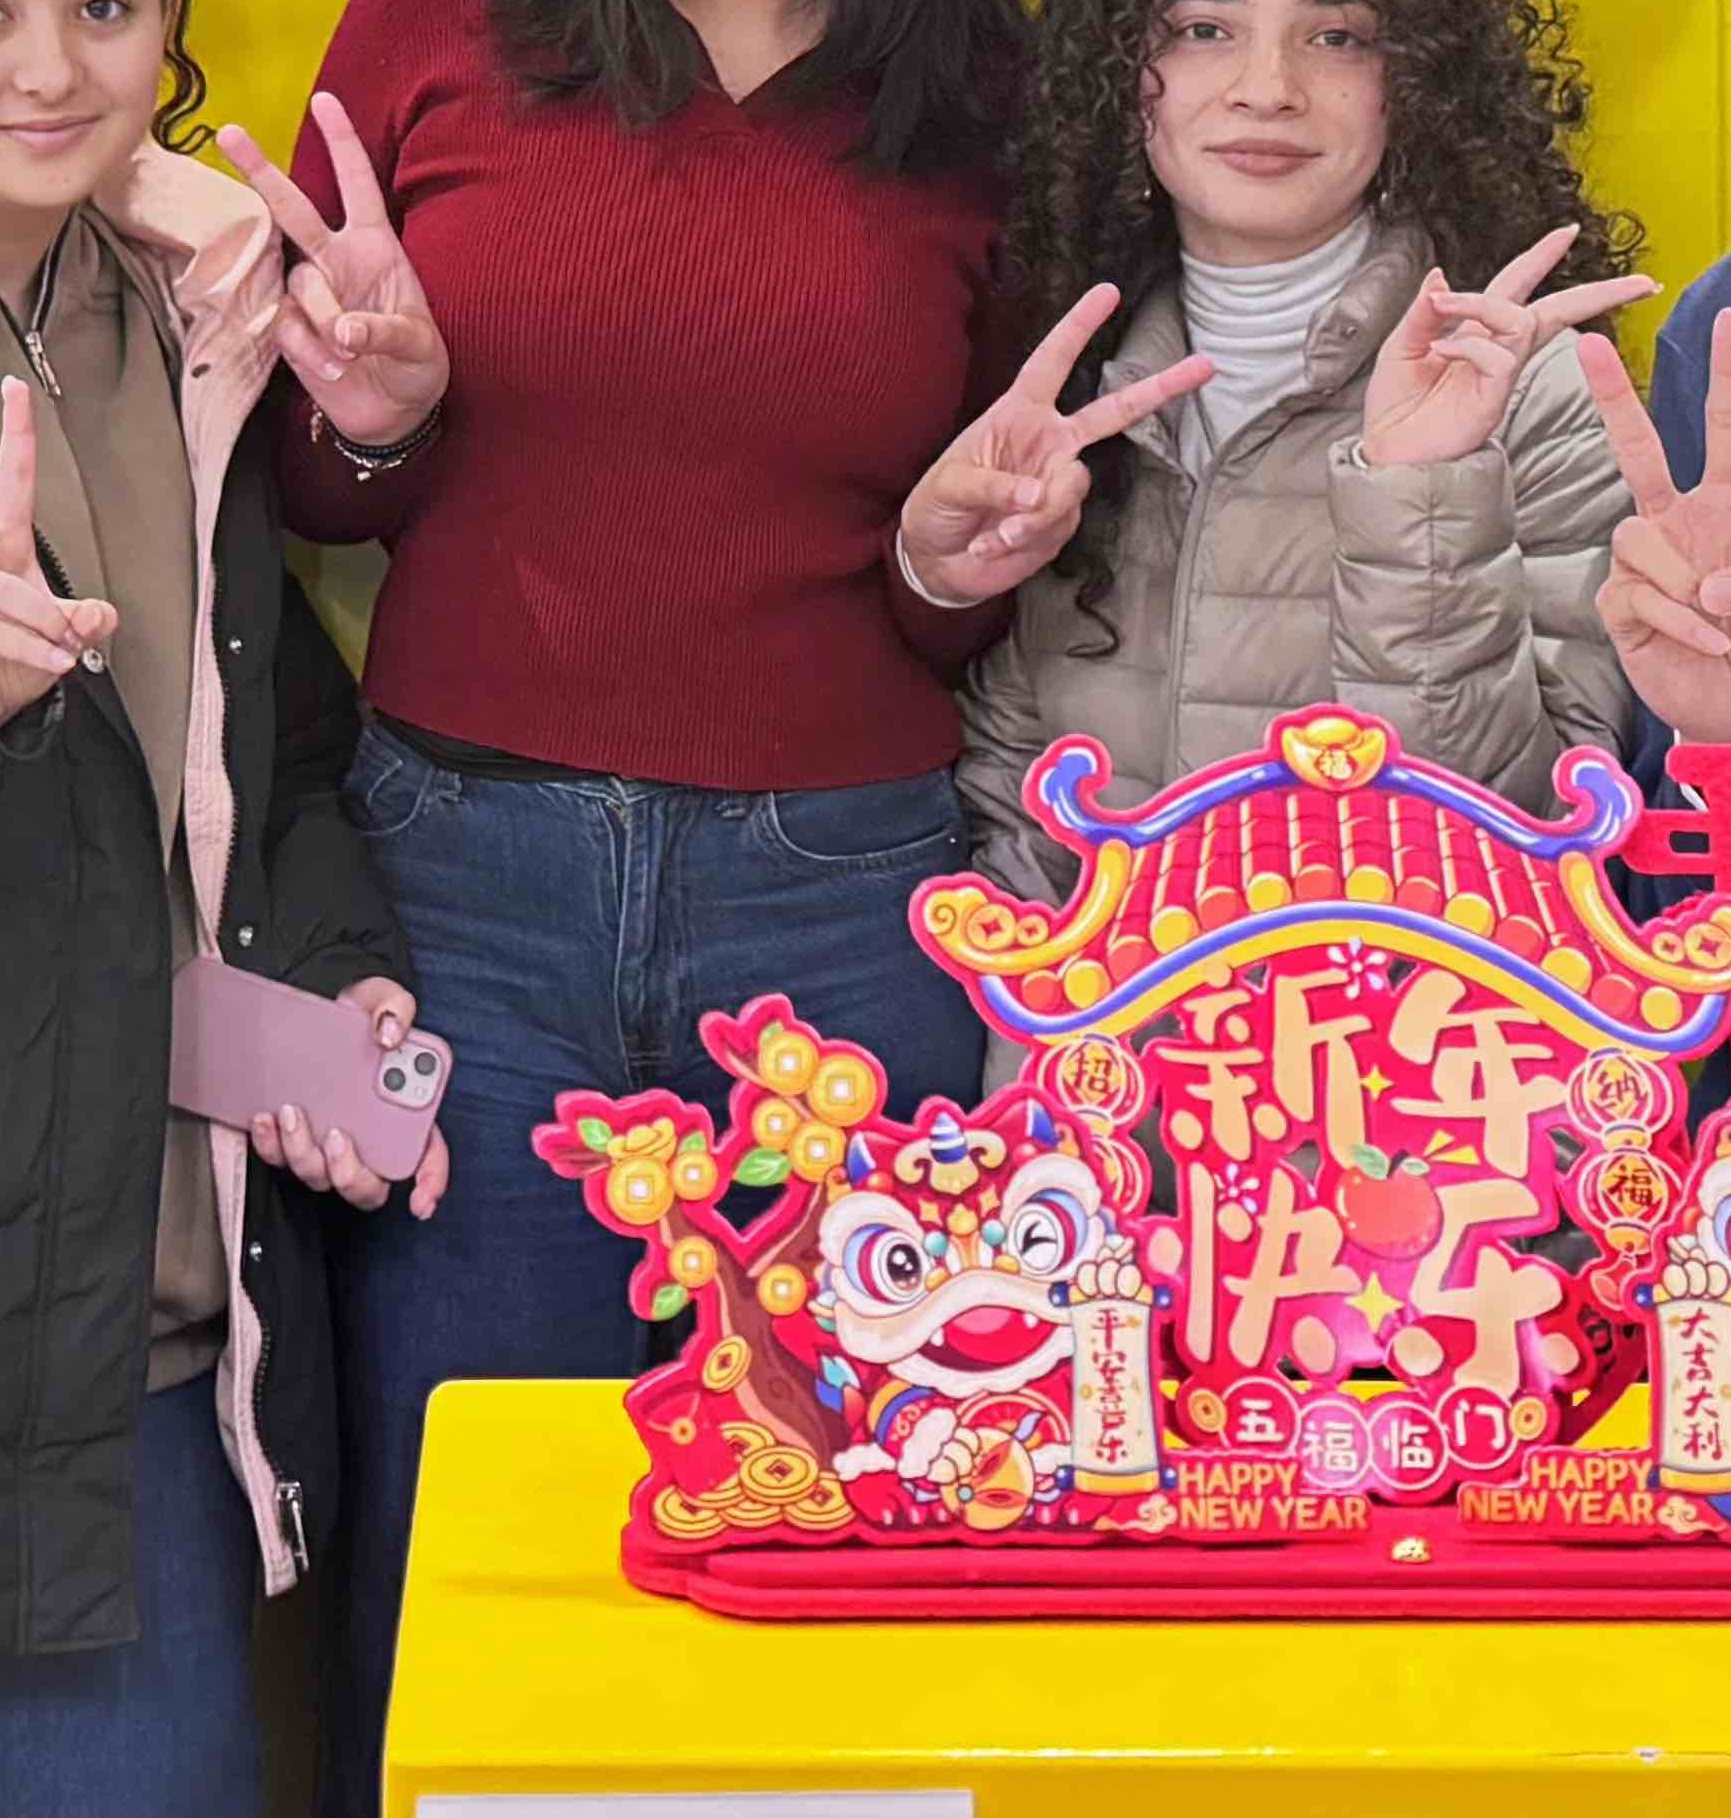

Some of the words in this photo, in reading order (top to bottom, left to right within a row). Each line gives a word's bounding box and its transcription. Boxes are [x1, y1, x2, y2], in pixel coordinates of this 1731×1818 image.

[1155, 961, 1568, 1178] 新年
[1680, 1307, 1723, 1460] 大吉大利
[1179, 1461, 1298, 1495] HAPPY
[1529, 1456, 1653, 1491] HAPPY
[1181, 1497, 1263, 1530] NEW
[1272, 1497, 1368, 1530] YEAR
[1462, 1488, 1548, 1523] NEW
[1558, 1491, 1656, 1526] YEAR
